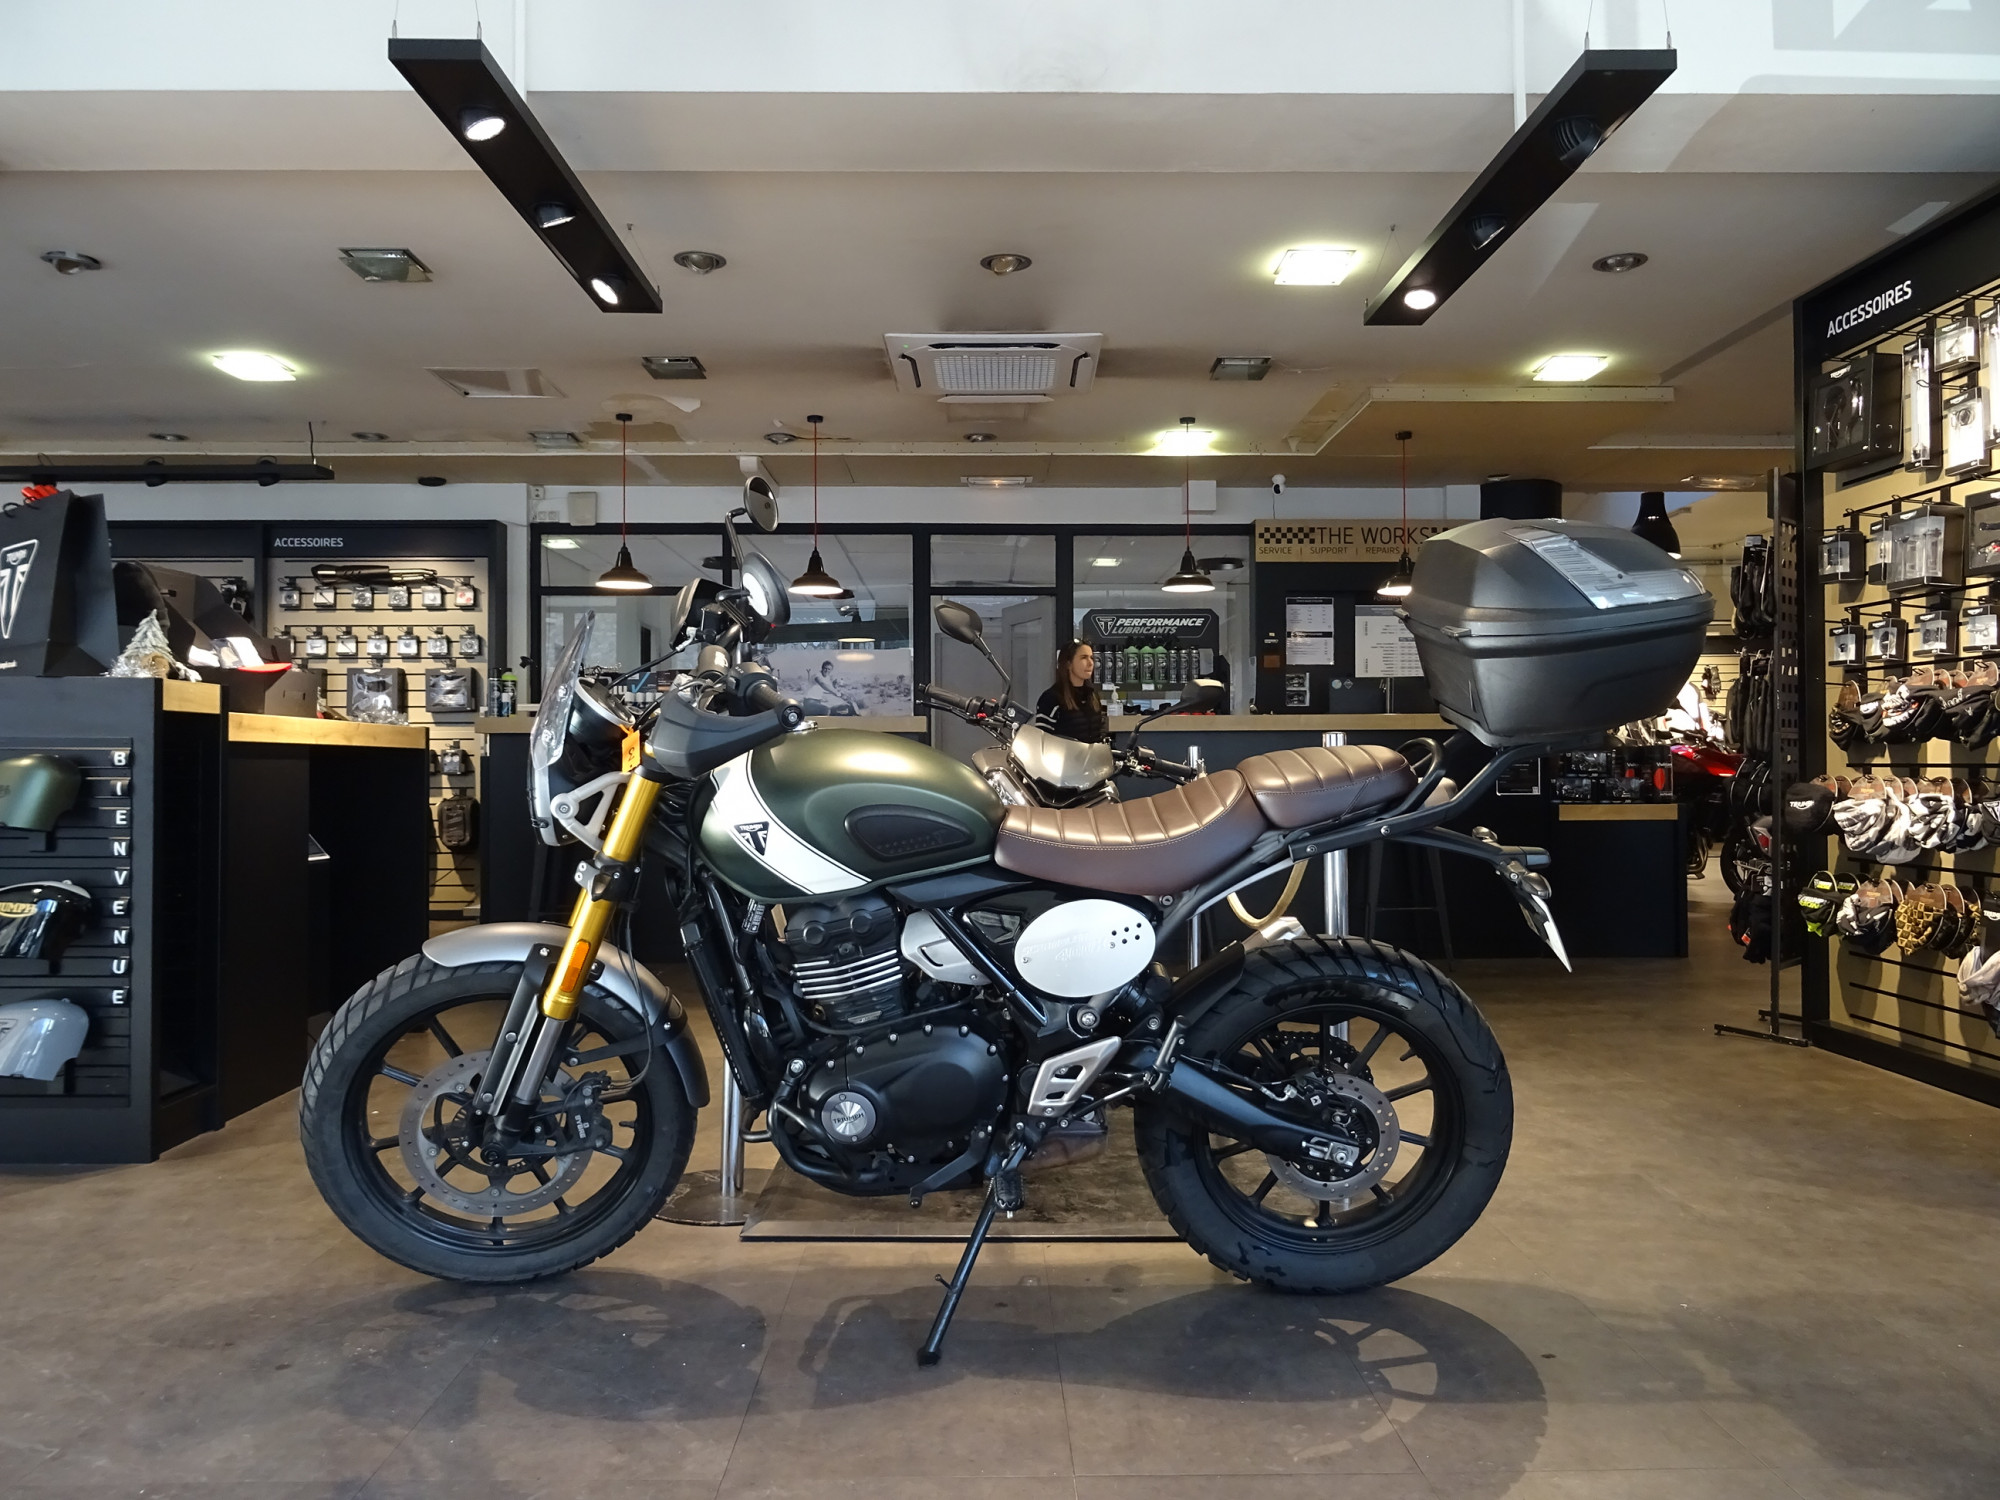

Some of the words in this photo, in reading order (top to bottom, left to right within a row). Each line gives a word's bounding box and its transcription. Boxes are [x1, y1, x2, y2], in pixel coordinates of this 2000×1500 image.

[1826, 280, 1912, 338] ACCESSOIRES
[1317, 527, 1353, 544] THE
[1361, 527, 1430, 544] WORKS
[274, 537, 344, 547] ACCESSOIRES
[1258, 547, 1292, 555] SERVICE
[1310, 547, 1347, 555] SUPPORT
[1365, 547, 1400, 555] REPAIRS
[1115, 618, 1204, 627] PERFORMANCE
[1111, 626, 1177, 635] LUBRICANTS
[833, 1113, 864, 1124] TRIUMPH
